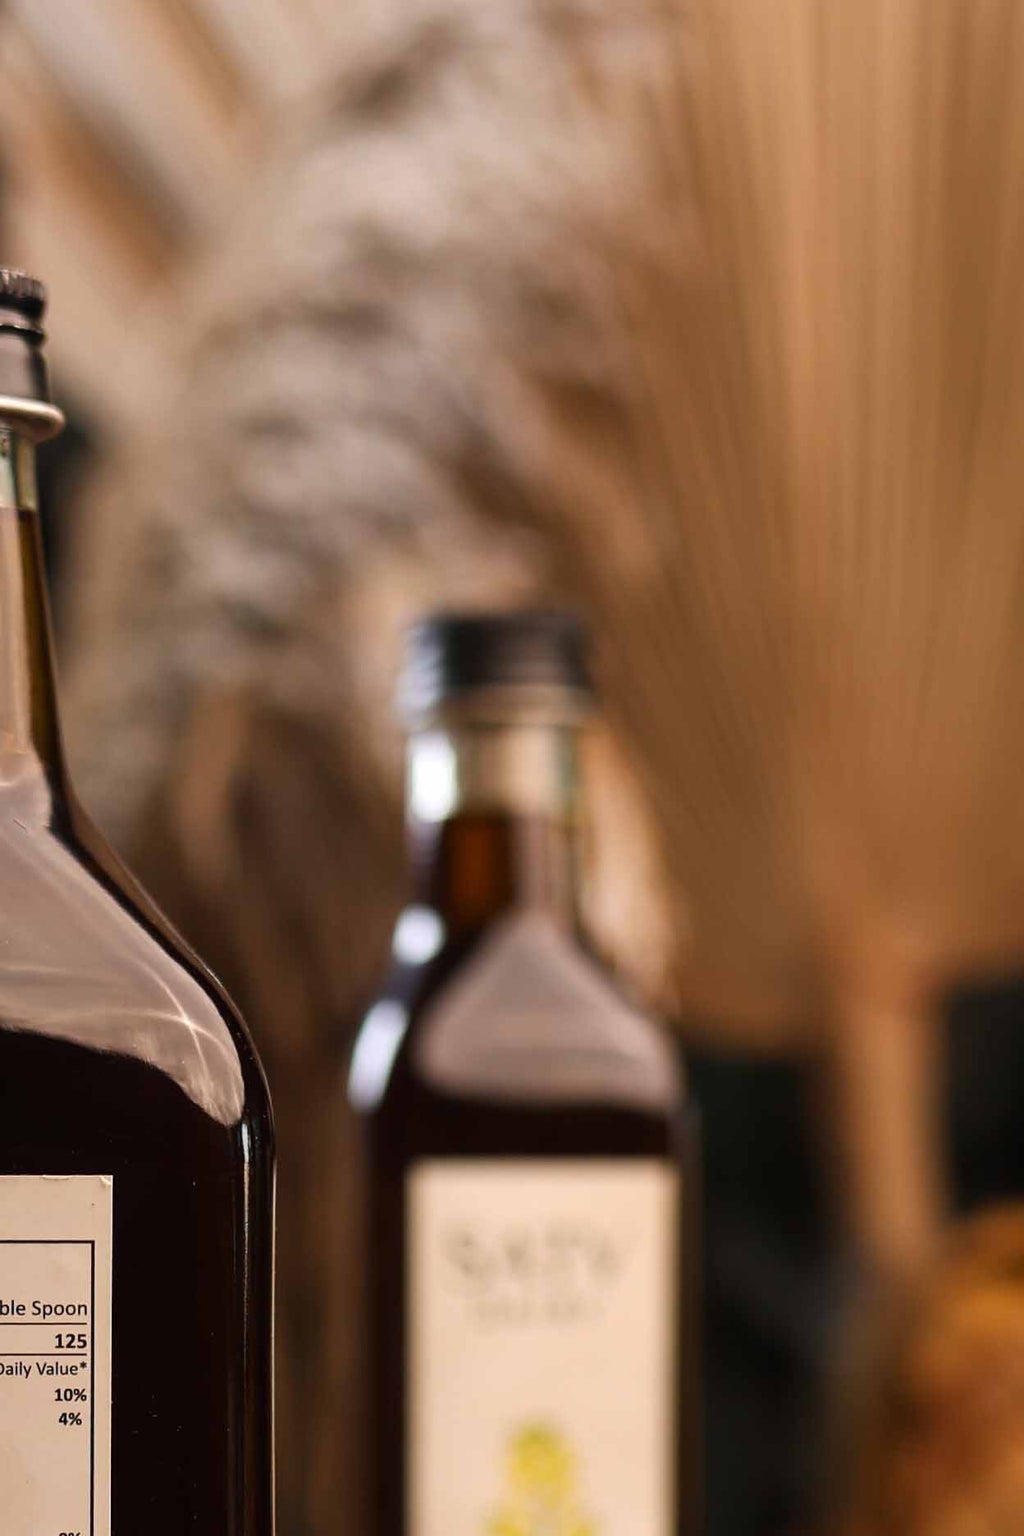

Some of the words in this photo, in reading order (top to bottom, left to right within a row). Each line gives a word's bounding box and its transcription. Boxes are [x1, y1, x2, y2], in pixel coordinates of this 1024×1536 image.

[31, 1299, 88, 1321] Spoon
[54, 1332, 88, 1350] 125
[53, 1387, 88, 1403] 10%
[58, 1411, 83, 1427] 4%
